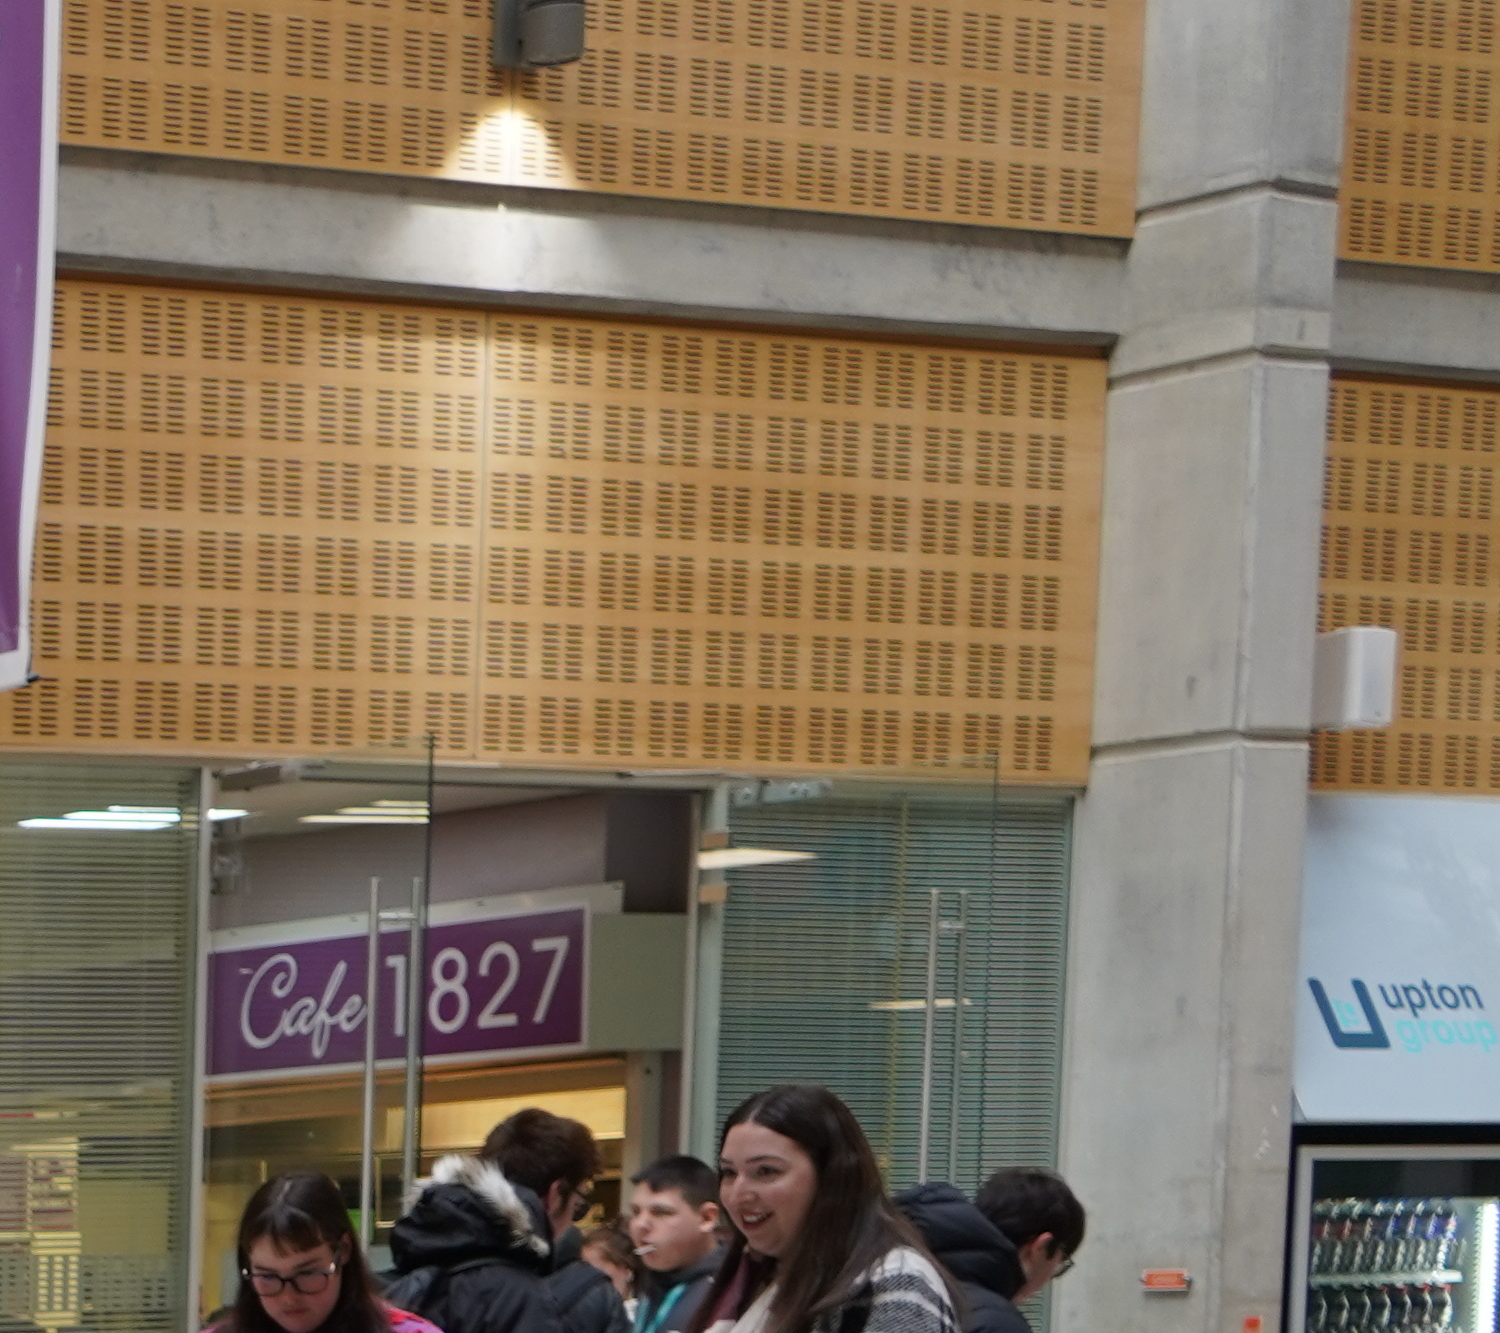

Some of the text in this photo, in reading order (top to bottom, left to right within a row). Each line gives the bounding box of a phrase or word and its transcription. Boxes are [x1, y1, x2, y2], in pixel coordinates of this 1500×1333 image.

[240, 936, 570, 1060] Cafe 1827
[1378, 978, 1485, 1018] upton
[1395, 1020, 1497, 1053] group
